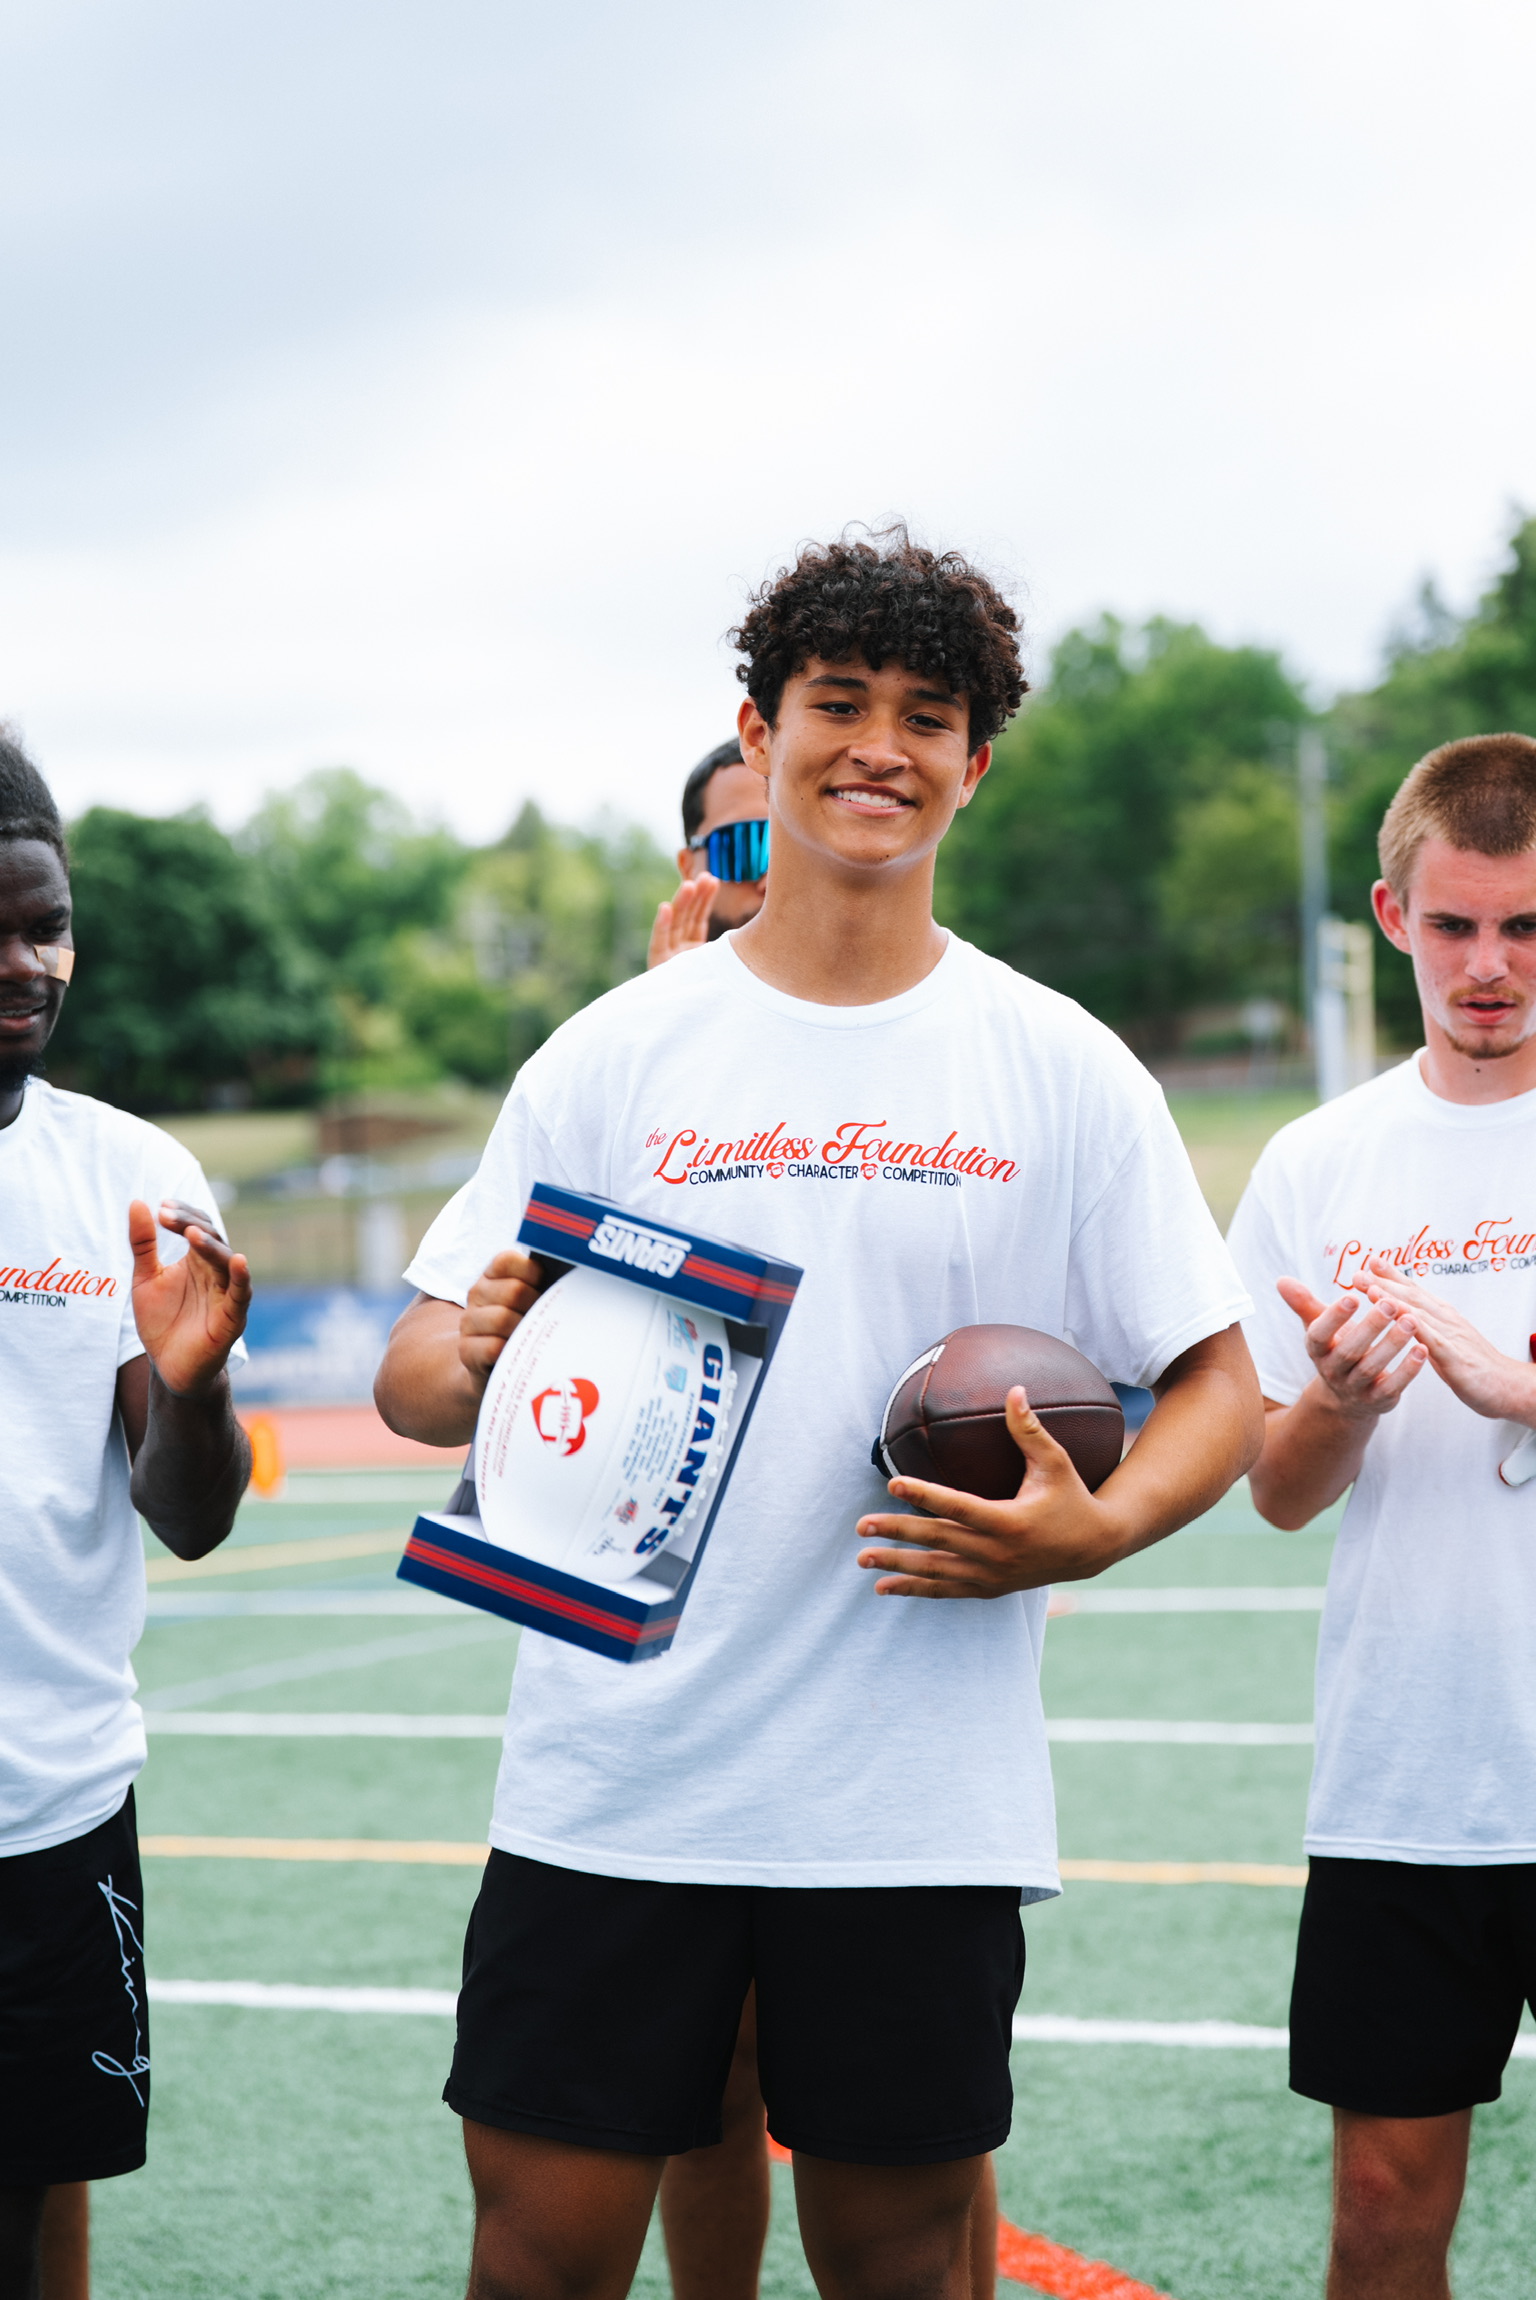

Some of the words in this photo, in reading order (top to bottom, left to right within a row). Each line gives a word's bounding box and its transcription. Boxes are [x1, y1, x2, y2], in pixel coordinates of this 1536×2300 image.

[645, 1127, 668, 1149] the
[653, 1122, 818, 1185] Limitless
[822, 1119, 1021, 1183] Foundation
[689, 1164, 764, 1185] COMMUNITY
[787, 1163, 859, 1179] CHARACTER
[882, 1166, 962, 1187] COMPETITION
[588, 1221, 687, 1279] GIANTS
[633, 1343, 724, 1556] GIANTS
